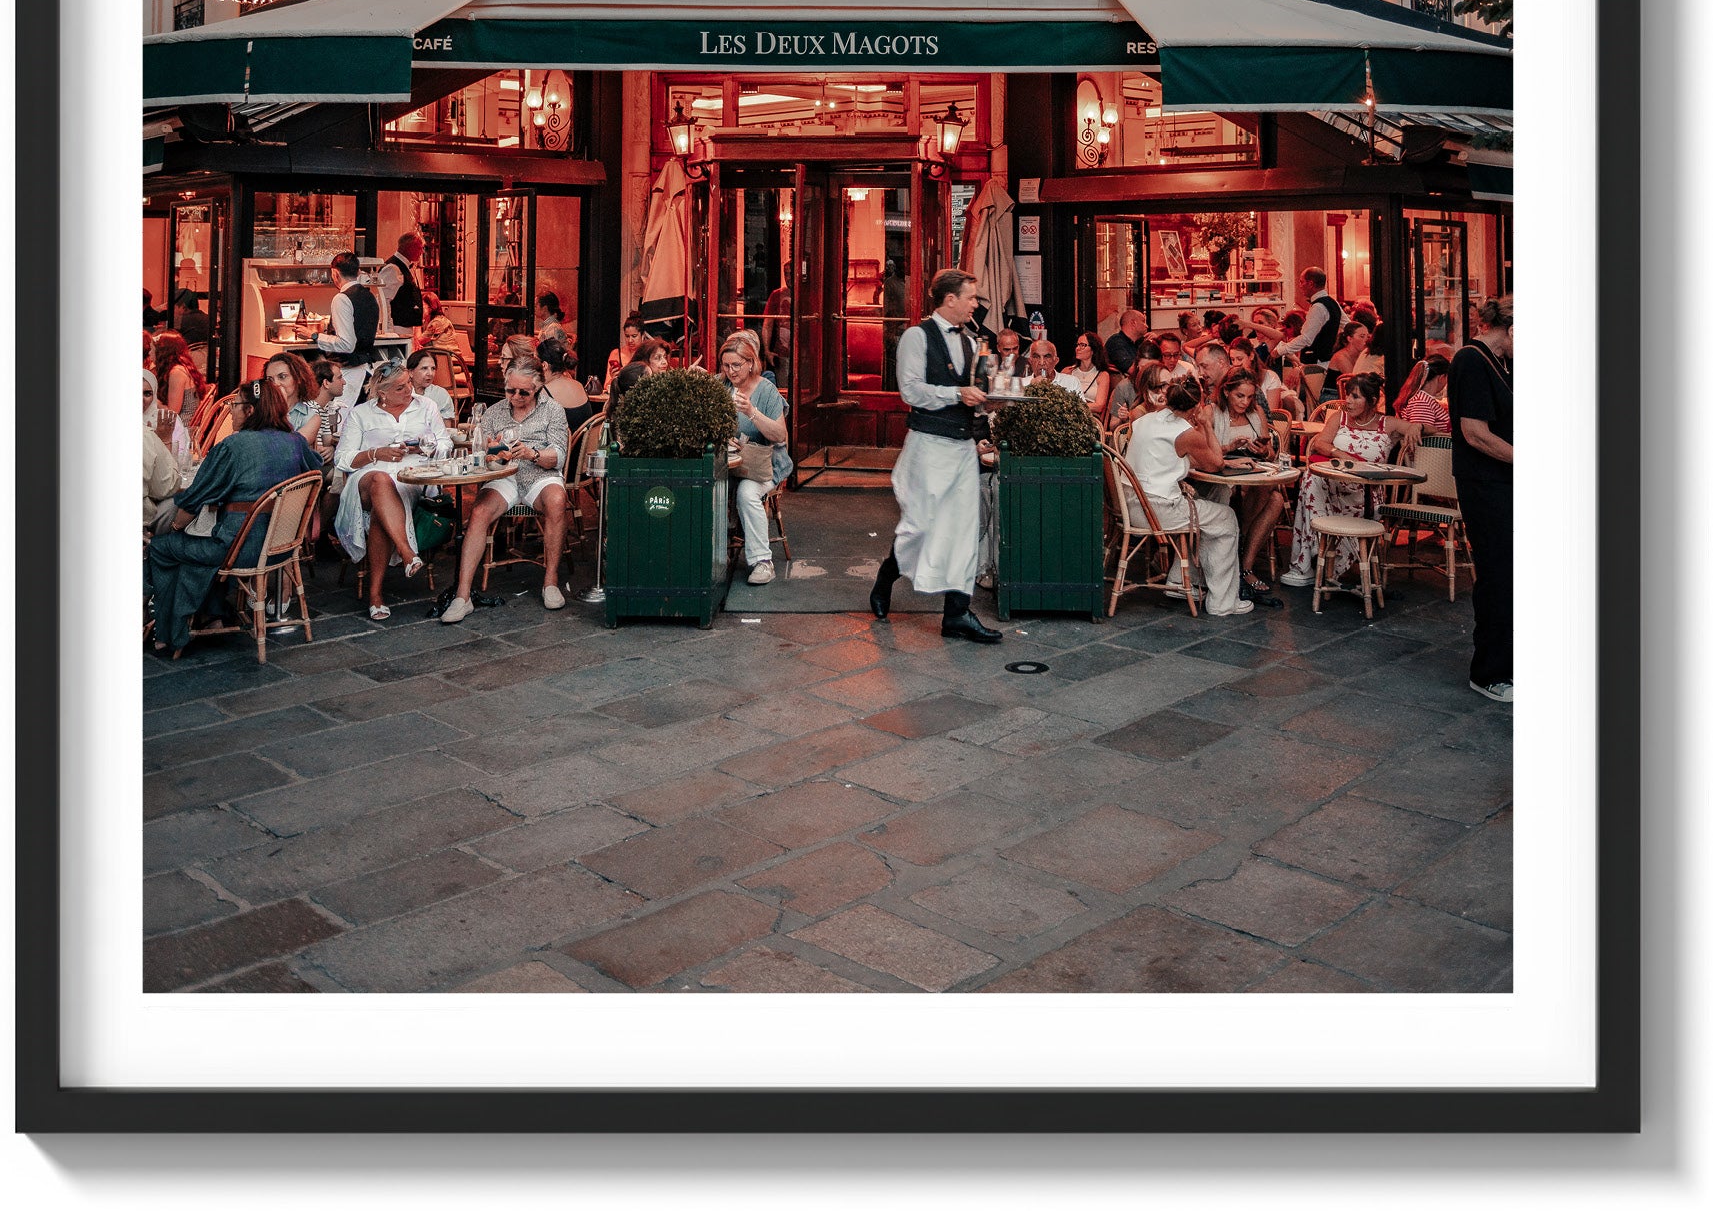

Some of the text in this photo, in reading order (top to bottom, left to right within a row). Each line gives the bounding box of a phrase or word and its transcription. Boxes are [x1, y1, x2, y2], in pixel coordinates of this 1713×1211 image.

[412, 34, 453, 50] CAFÉ
[700, 31, 939, 55] LES DEUX MAGOTS
